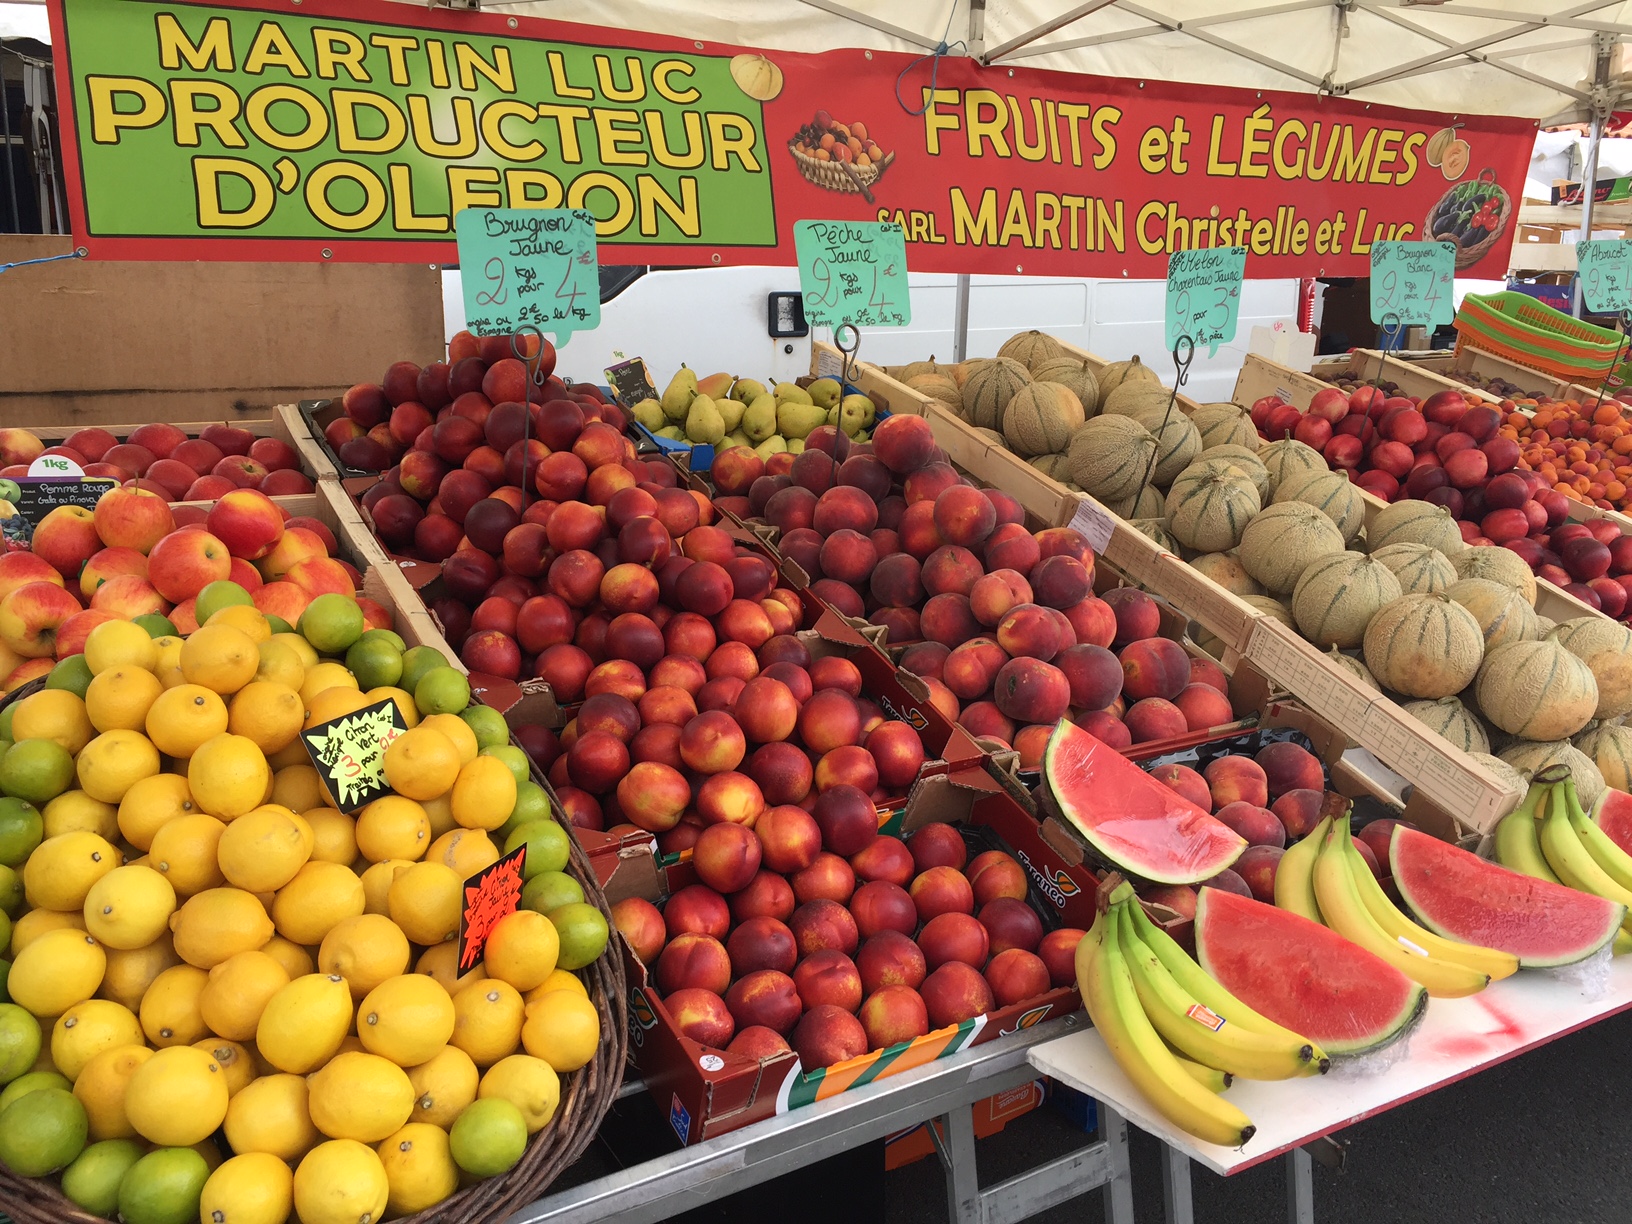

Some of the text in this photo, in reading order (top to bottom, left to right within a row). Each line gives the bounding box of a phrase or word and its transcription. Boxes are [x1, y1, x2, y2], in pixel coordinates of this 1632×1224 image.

[155, 12, 702, 105] MARTIN LUC
[85, 73, 763, 173] PRODUCTEUR
[920, 86, 1427, 186] FRUITS et LÉGUMES
[484, 211, 574, 243] Brugnon
[950, 187, 1126, 253] MARTIN
[1136, 200, 1310, 255] Christelle
[1314, 211, 1348, 255] et
[807, 223, 874, 245] Pêche
[509, 239, 573, 256] Jaune
[825, 246, 878, 264] Jaune
[1591, 242, 1627, 262] Abricot
[1180, 250, 1223, 272] Melon
[1407, 262, 1433, 273] Blanc
[476, 257, 508, 306] 2
[517, 283, 545, 298] pour
[806, 257, 839, 308] 2
[1168, 270, 1241, 292] Charentais Jaune
[1375, 270, 1400, 309] 2
[843, 286, 863, 299] pour
[572, 306, 591, 321] kg
[1193, 310, 1207, 324] pour
[42, 459, 69, 471] 1kg
[39, 483, 79, 495] Pomme
[82, 483, 110, 493] Rouge
[38, 495, 57, 505] Gala
[69, 495, 97, 505] Pinova
[345, 723, 375, 741] Citron
[356, 732, 379, 750] Vert
[341, 755, 361, 777] 3
[361, 751, 378, 768] pour
